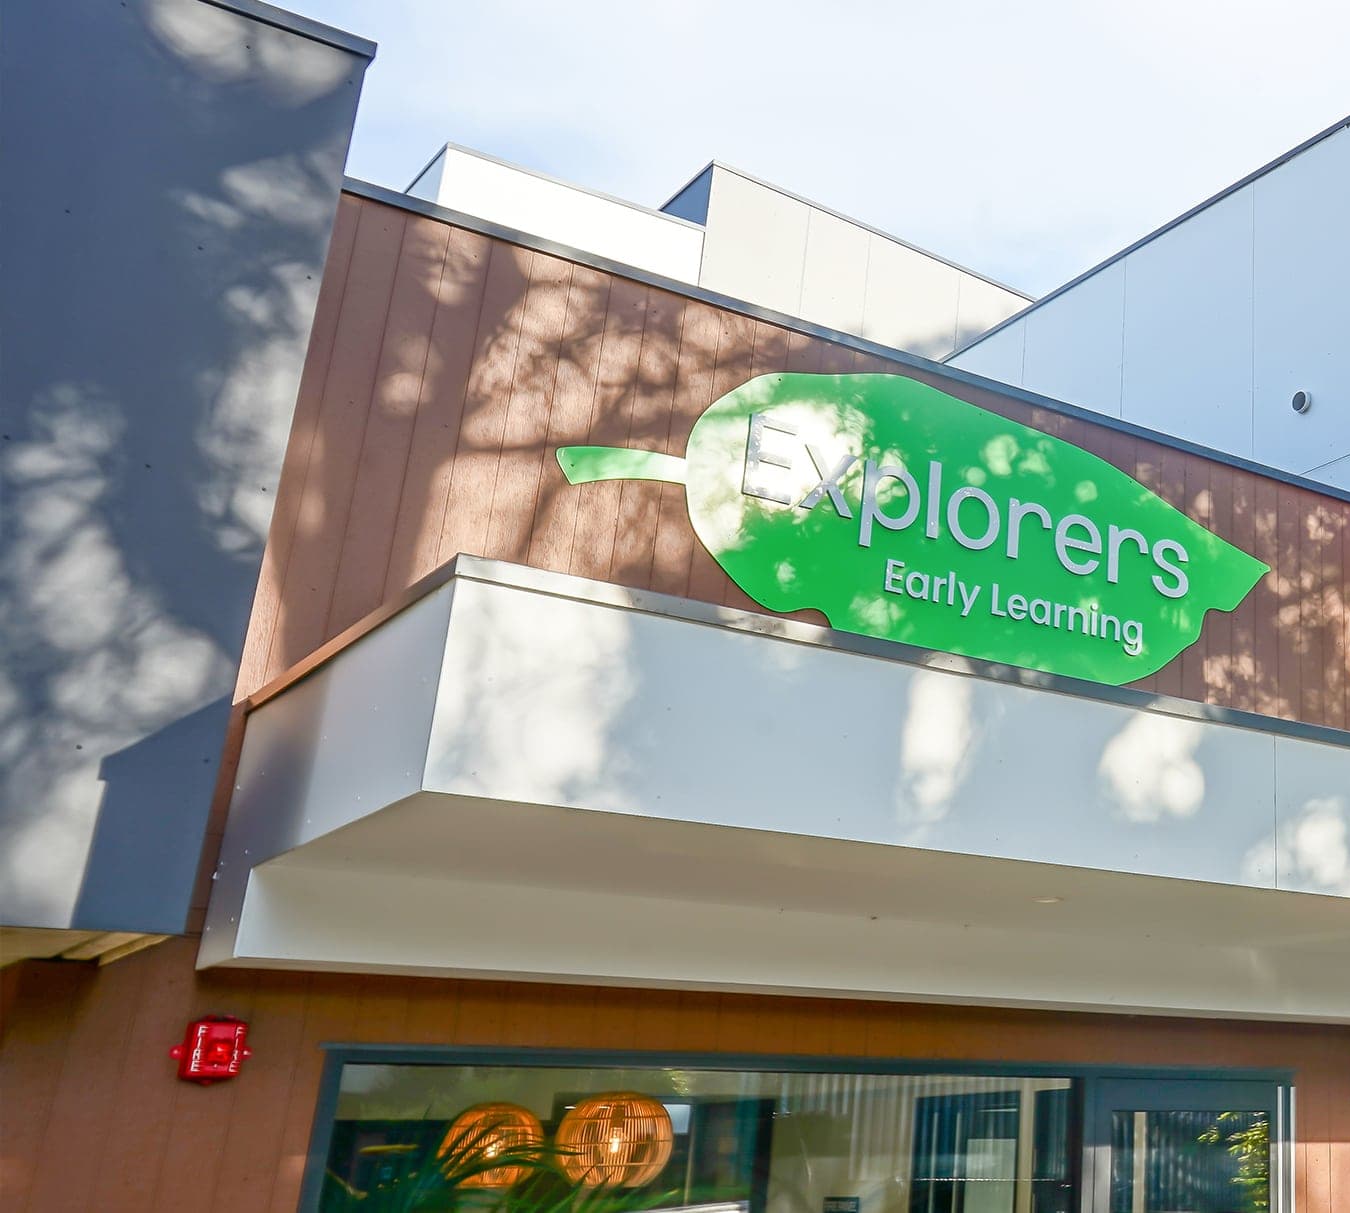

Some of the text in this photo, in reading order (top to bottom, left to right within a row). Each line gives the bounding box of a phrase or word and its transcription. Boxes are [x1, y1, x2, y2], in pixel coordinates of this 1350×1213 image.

[742, 413, 1189, 599] Explorers
[884, 558, 1143, 656] Early Learning
[190, 1026, 208, 1072] FIRE
[229, 1026, 246, 1073] FIRE
